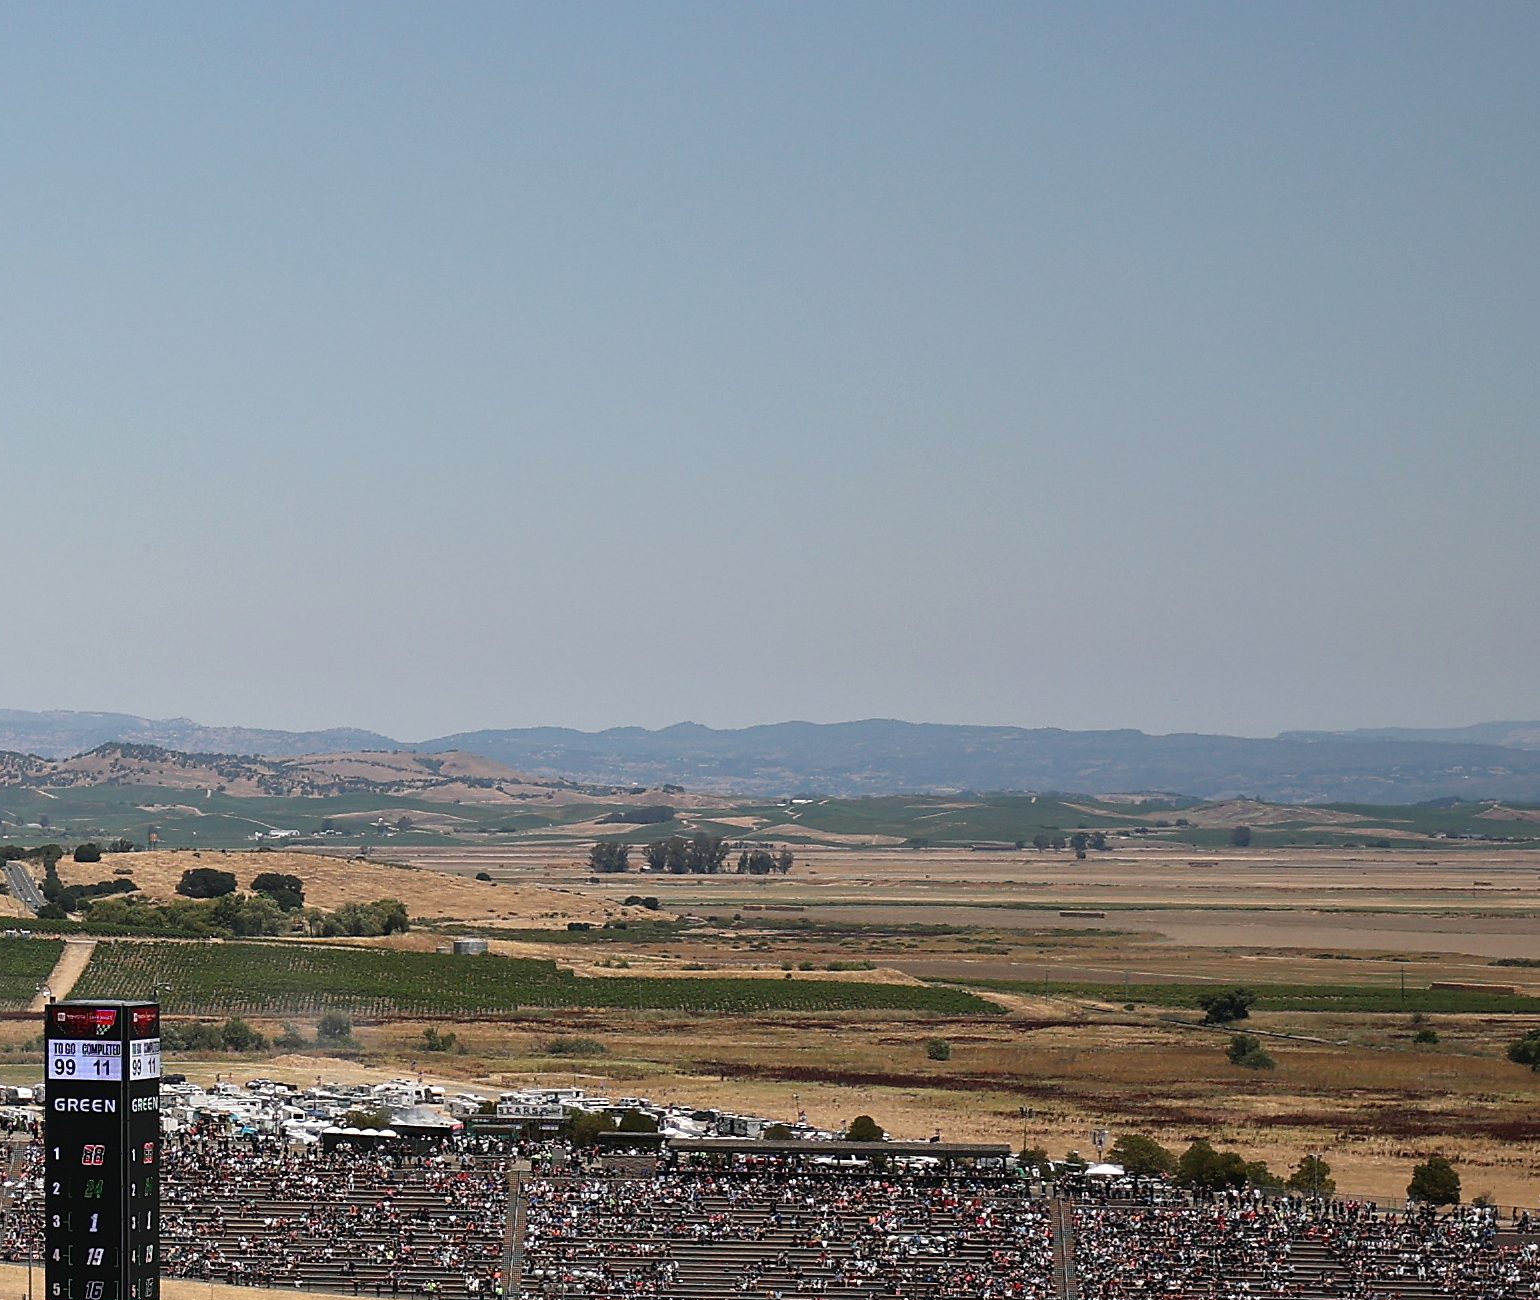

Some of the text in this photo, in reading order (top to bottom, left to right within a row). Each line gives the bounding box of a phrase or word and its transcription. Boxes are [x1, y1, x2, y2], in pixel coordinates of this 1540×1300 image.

[54, 1043, 76, 1054] TO GO
[82, 1043, 121, 1055] COMPLETED
[55, 1059, 76, 1076] 99
[93, 1060, 110, 1076] 11
[148, 1057, 156, 1074] 11
[54, 1098, 116, 1113] GREEN
[132, 1096, 159, 1113] GREEN
[54, 1147, 60, 1160] 1
[82, 1144, 105, 1165] 88
[52, 1182, 60, 1195] 2
[84, 1180, 104, 1198] 24
[52, 1214, 60, 1228] 3
[89, 1213, 99, 1232] 1
[52, 1248, 60, 1261] 4
[86, 1248, 104, 1266] 19
[53, 1283, 61, 1296] 5
[86, 1281, 104, 1300] 16
